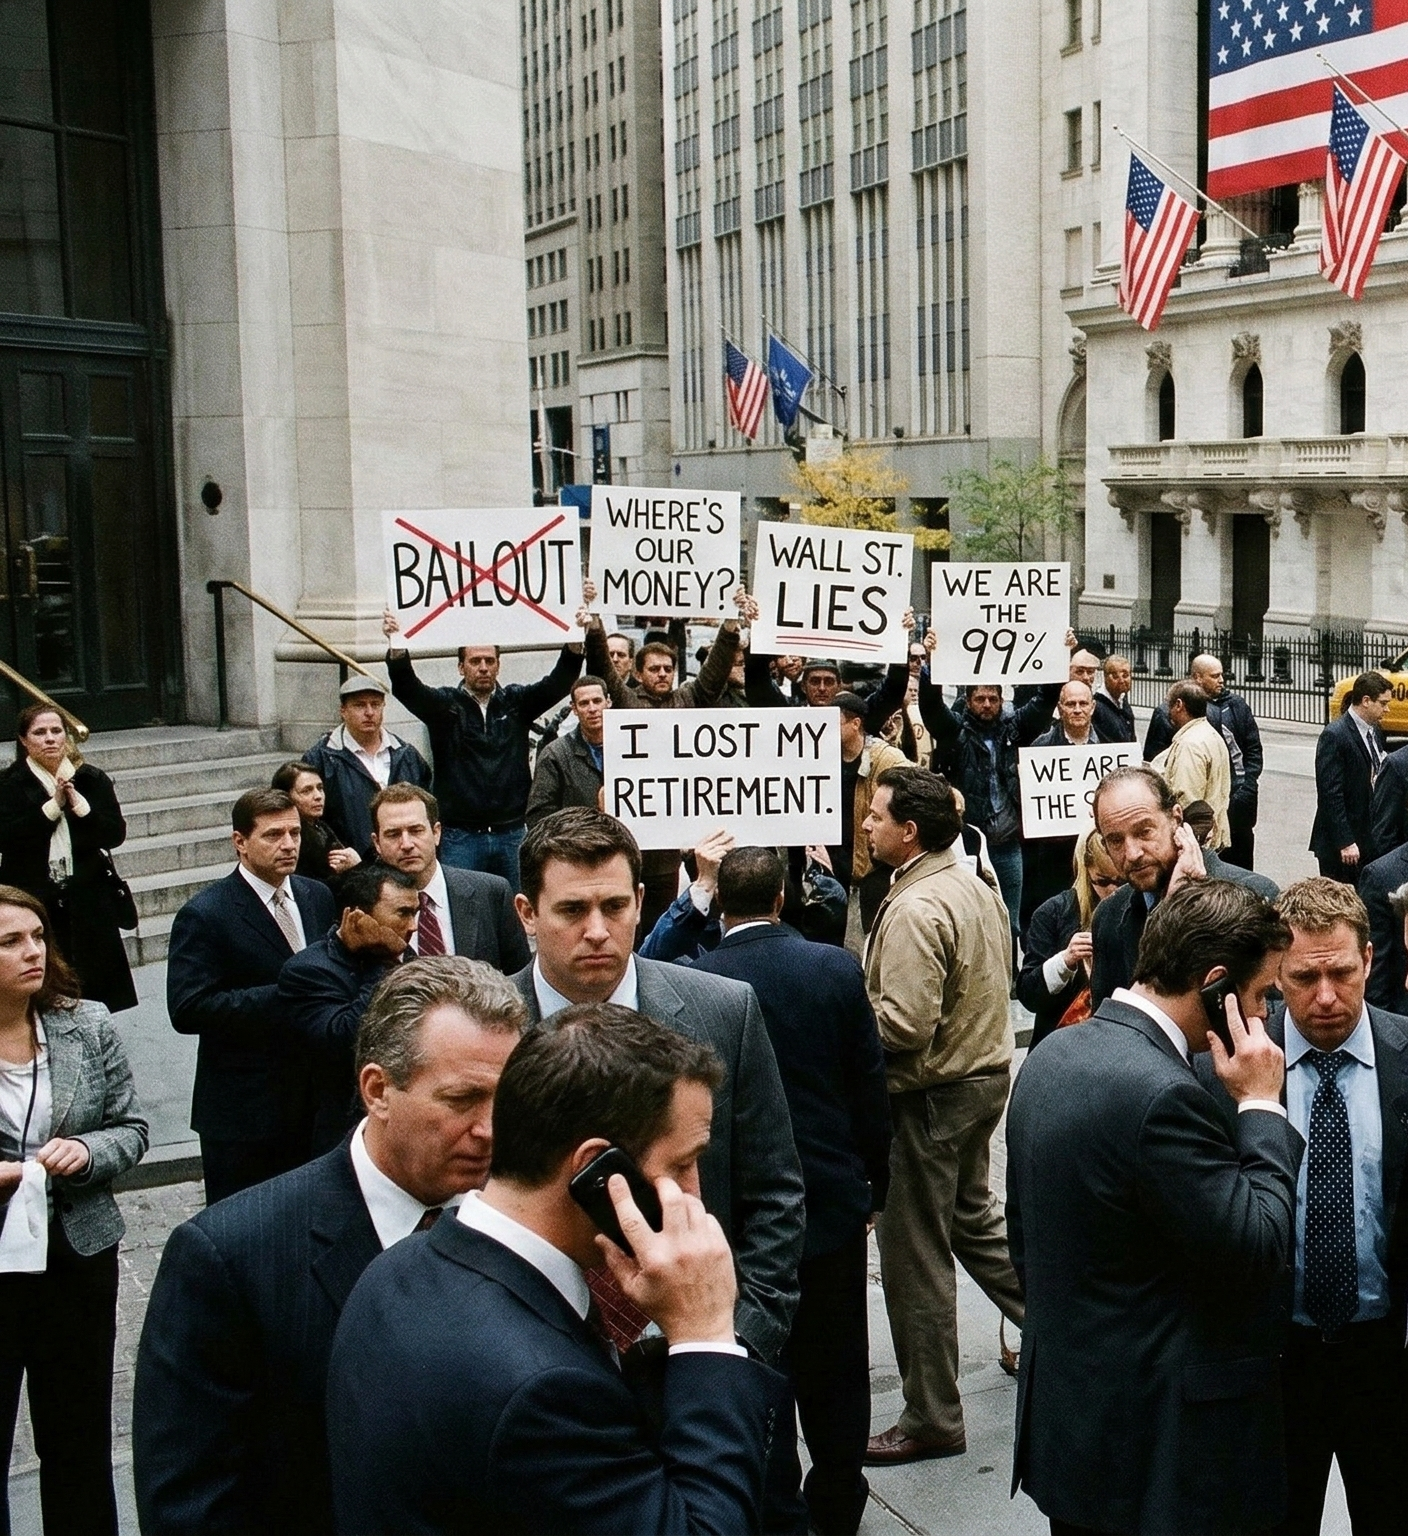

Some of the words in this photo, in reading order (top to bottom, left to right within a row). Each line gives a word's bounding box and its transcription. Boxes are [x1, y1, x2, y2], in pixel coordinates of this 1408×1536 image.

[606, 497, 724, 534] WHERE'S
[636, 538, 694, 564] OUR
[770, 533, 851, 572] WALL
[862, 541, 903, 577] ST.
[394, 540, 574, 609] BAILOUT
[604, 568, 735, 610] MONEY?
[943, 570, 992, 596] WE
[1005, 569, 1061, 596] ARE
[777, 582, 888, 635] LIES
[980, 604, 1027, 623] THE
[963, 629, 1047, 674] 99%
[620, 724, 648, 758] I
[674, 723, 760, 758] LOST
[778, 723, 828, 759] MY
[1031, 758, 1073, 782] WE
[614, 776, 832, 817] RETIREMENT.
[1031, 794, 1077, 819] THE
